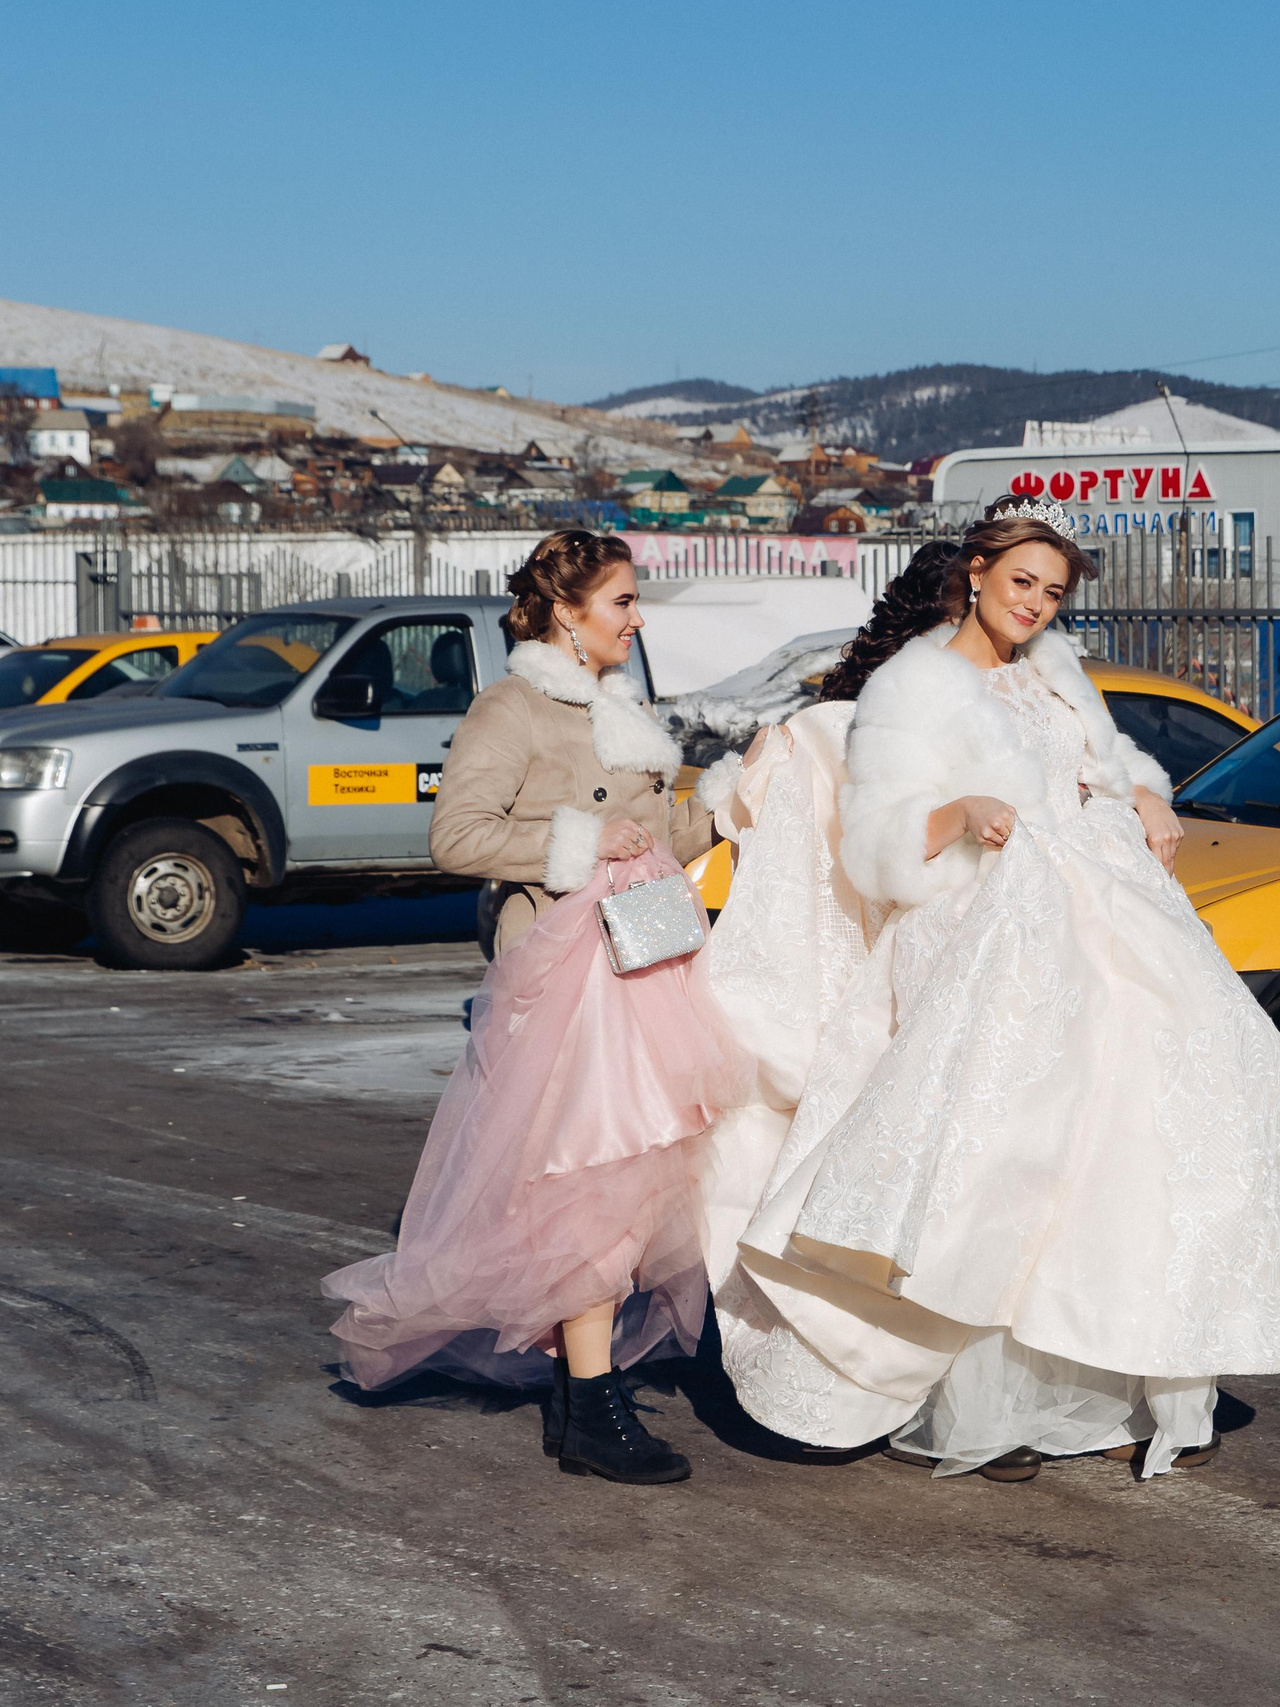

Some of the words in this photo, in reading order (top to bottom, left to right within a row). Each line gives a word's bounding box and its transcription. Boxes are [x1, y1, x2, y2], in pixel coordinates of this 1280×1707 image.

[1009, 464, 1214, 503] ФОРТУНА
[333, 768, 389, 778] Восточная
[333, 784, 376, 793] Техника
[418, 772, 443, 793] CA
